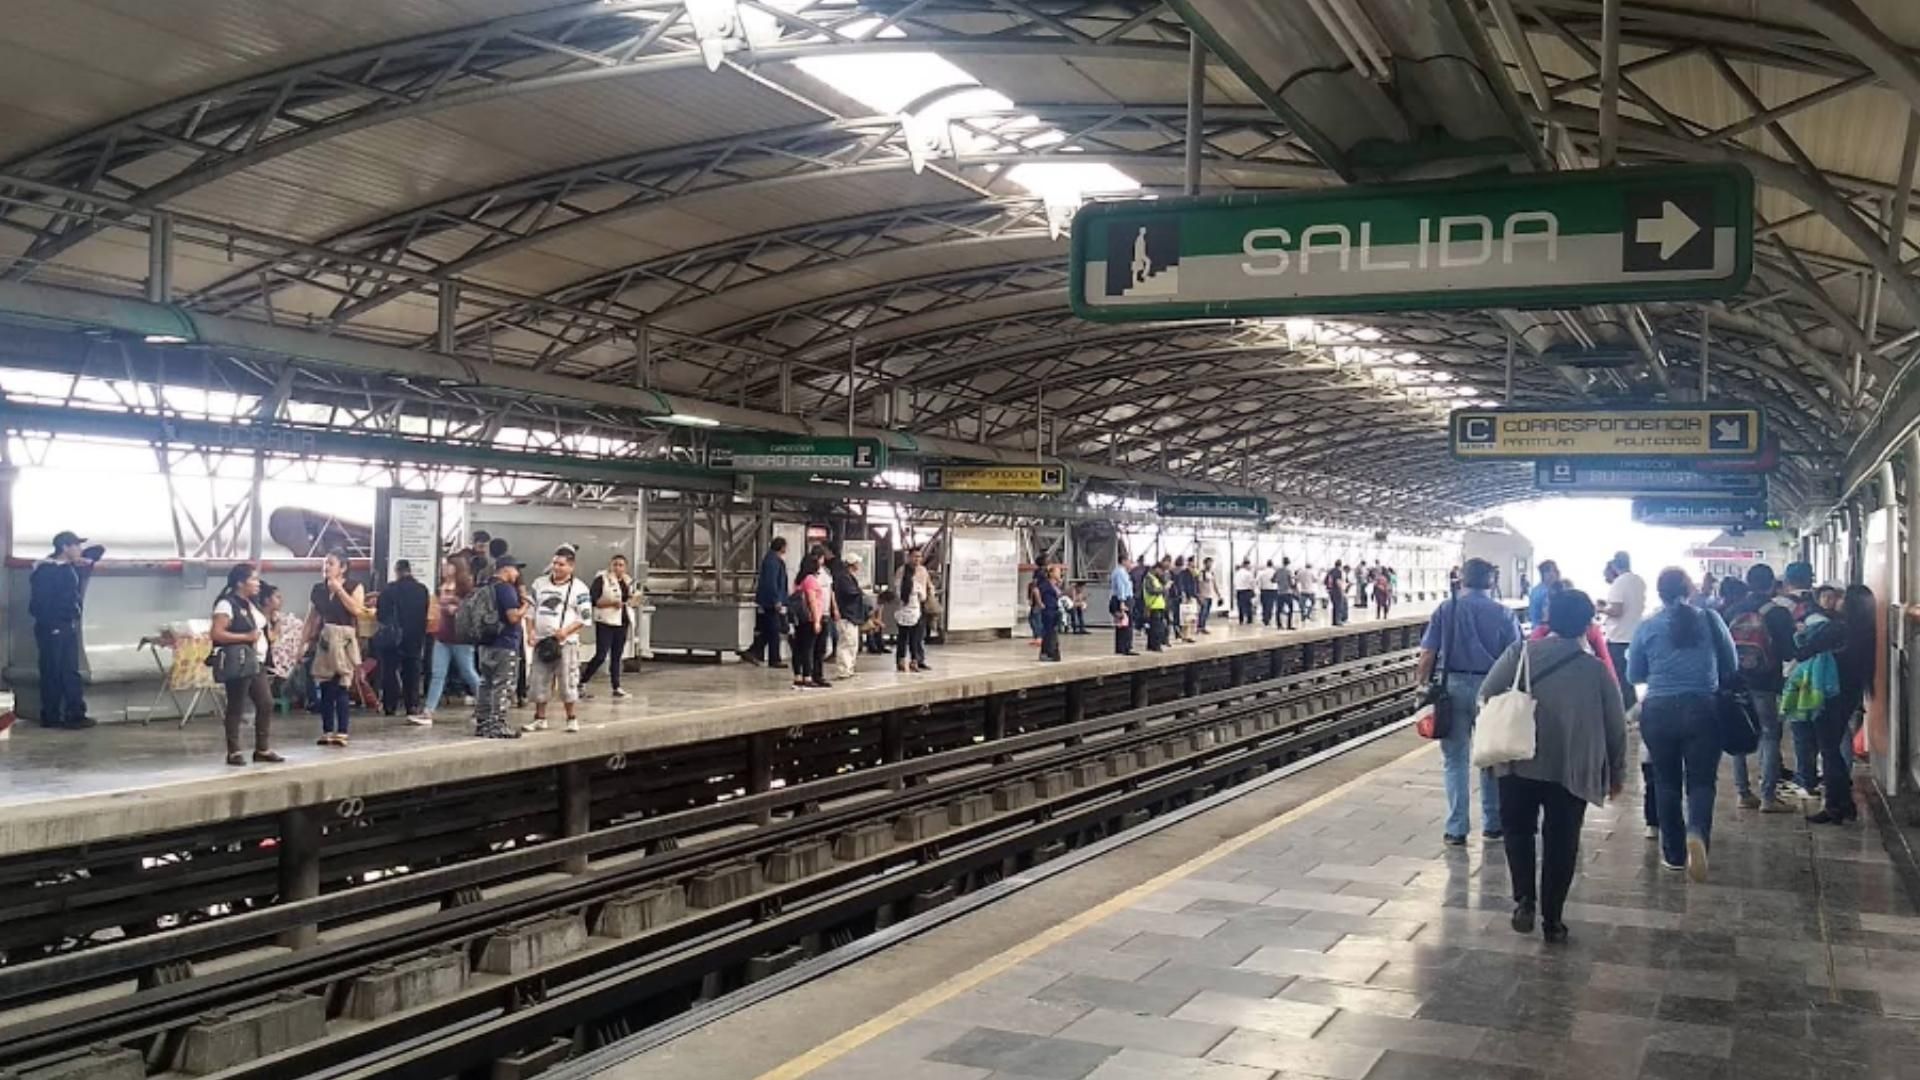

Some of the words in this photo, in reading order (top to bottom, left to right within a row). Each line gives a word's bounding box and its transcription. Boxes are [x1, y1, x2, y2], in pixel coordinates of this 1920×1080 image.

[1241, 211, 1558, 275] SALIDA
[1466, 418, 1489, 440] C
[1503, 417, 1702, 432] CORRESPONDENCIA
[791, 455, 850, 467] AZTECA
